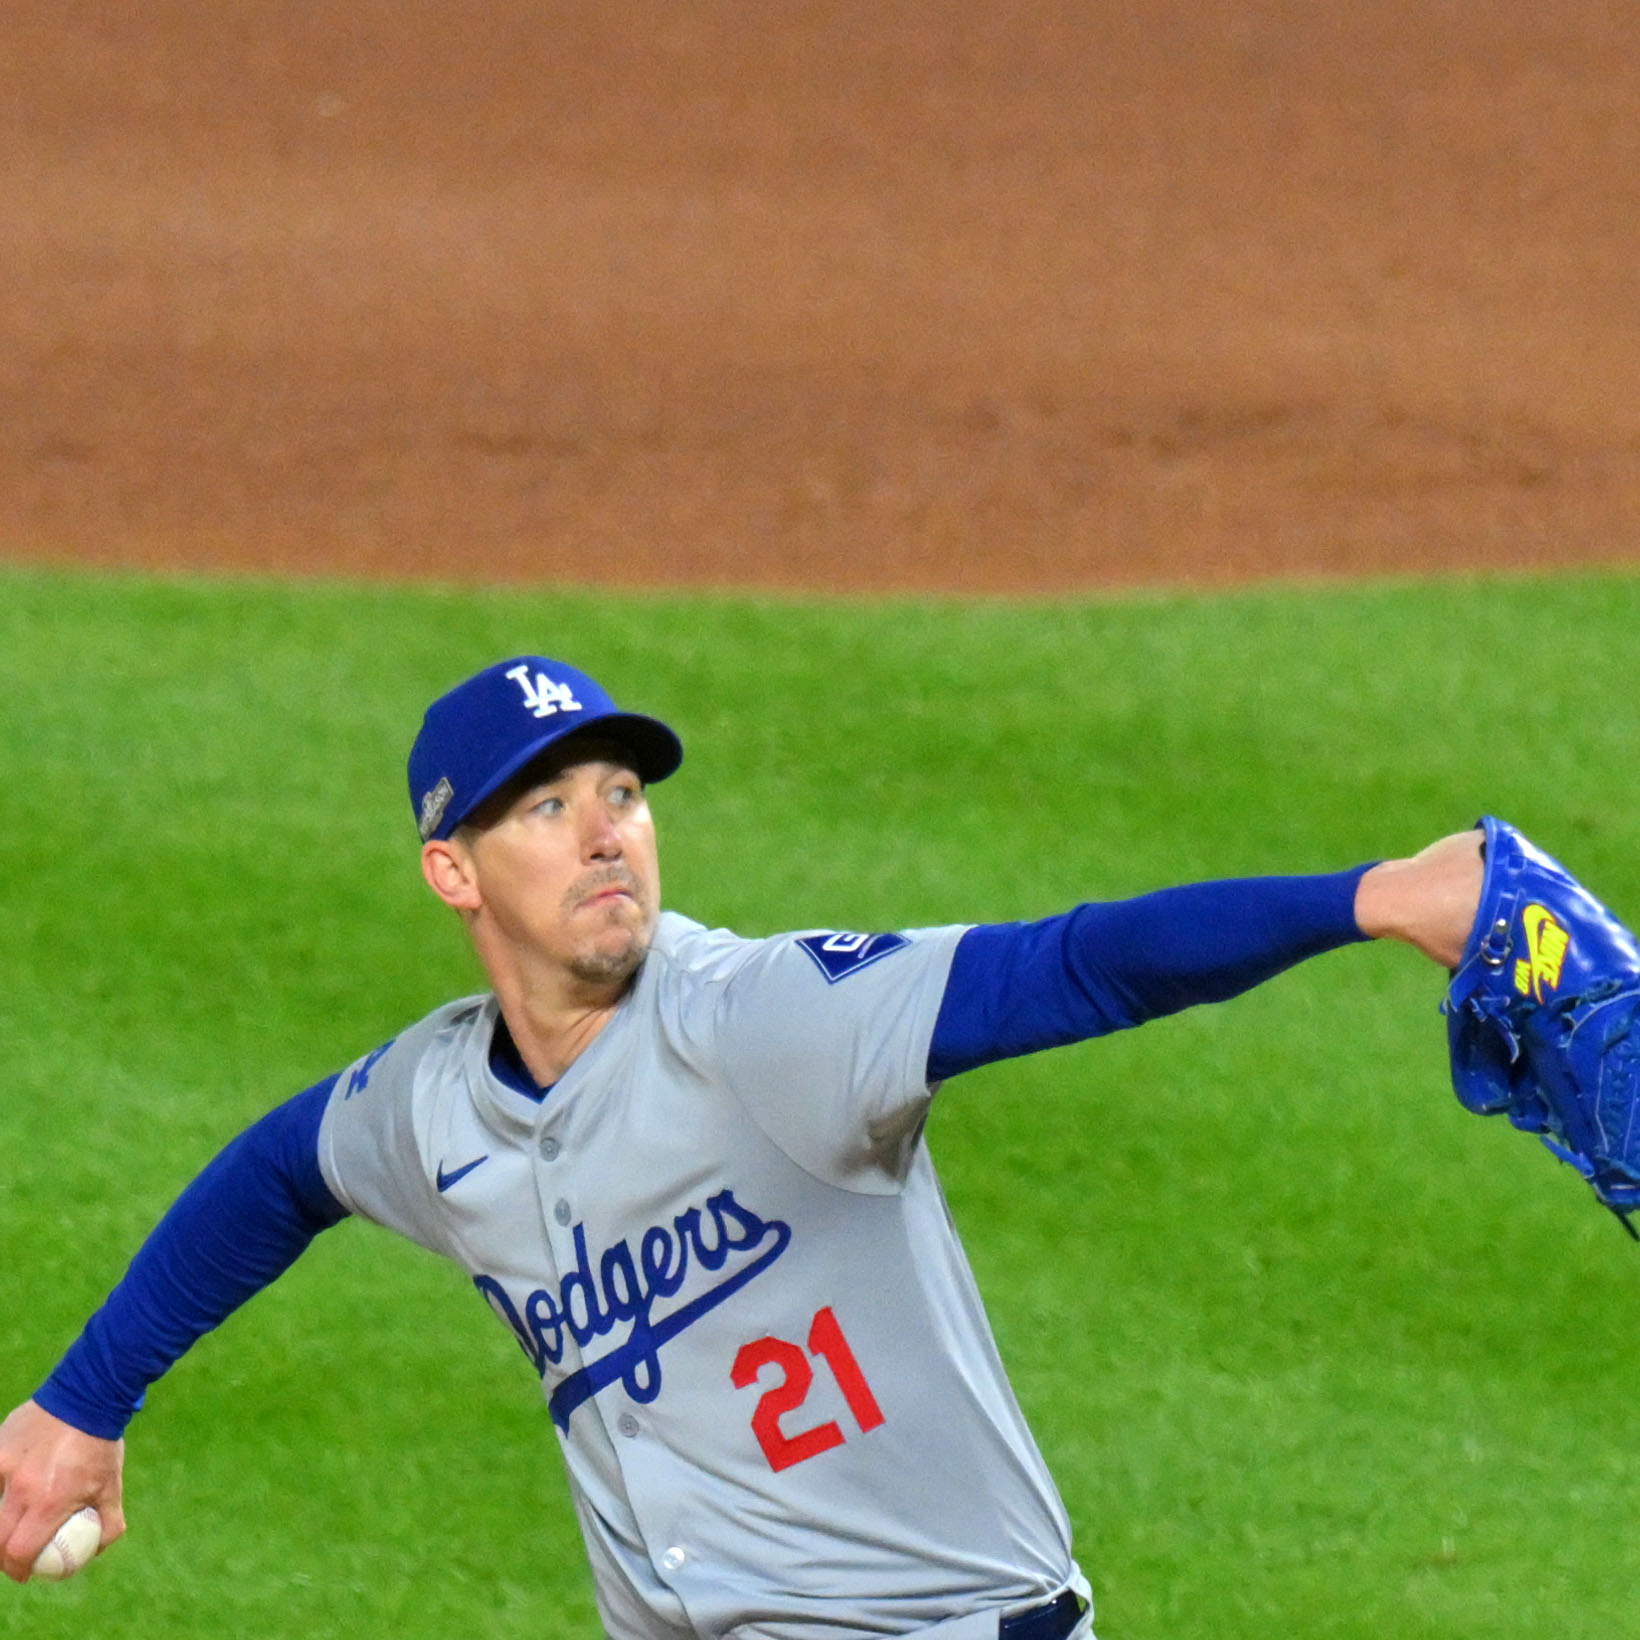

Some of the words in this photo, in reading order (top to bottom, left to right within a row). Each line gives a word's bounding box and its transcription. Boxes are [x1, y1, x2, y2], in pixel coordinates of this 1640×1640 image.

[505, 664, 583, 719] LA
[1537, 918, 1571, 991] NIKE
[729, 1305, 886, 1474] 21
